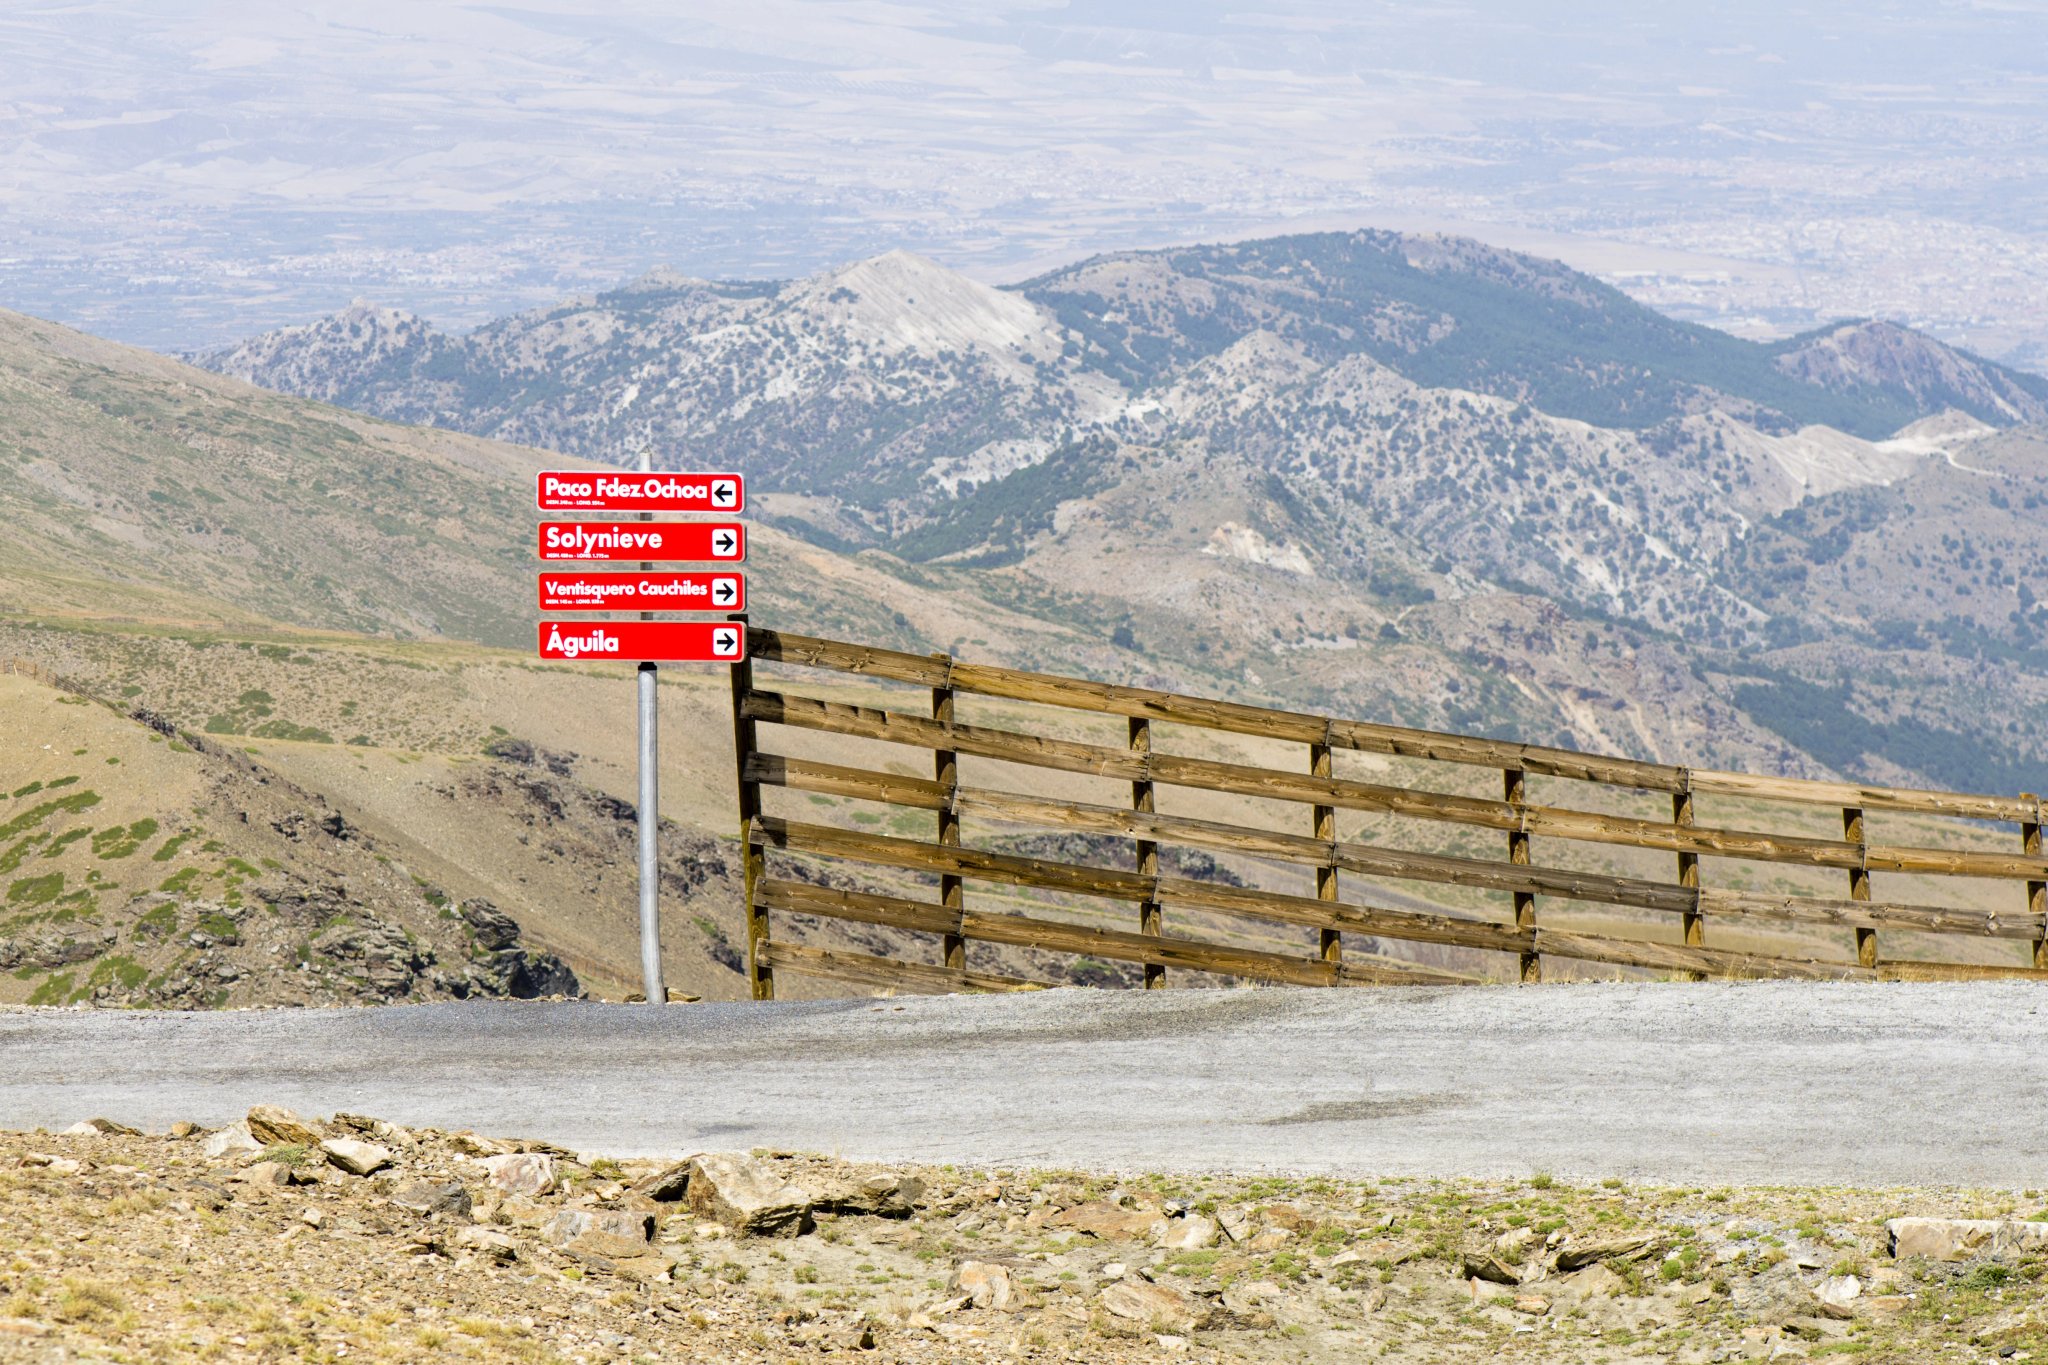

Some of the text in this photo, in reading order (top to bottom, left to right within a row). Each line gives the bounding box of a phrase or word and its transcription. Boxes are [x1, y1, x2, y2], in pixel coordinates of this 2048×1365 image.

[546, 478, 592, 497] Paco
[547, 526, 662, 553] Solynieve
[546, 580, 708, 599] Ventisquero Cauchiles
[546, 624, 619, 658] Águila
